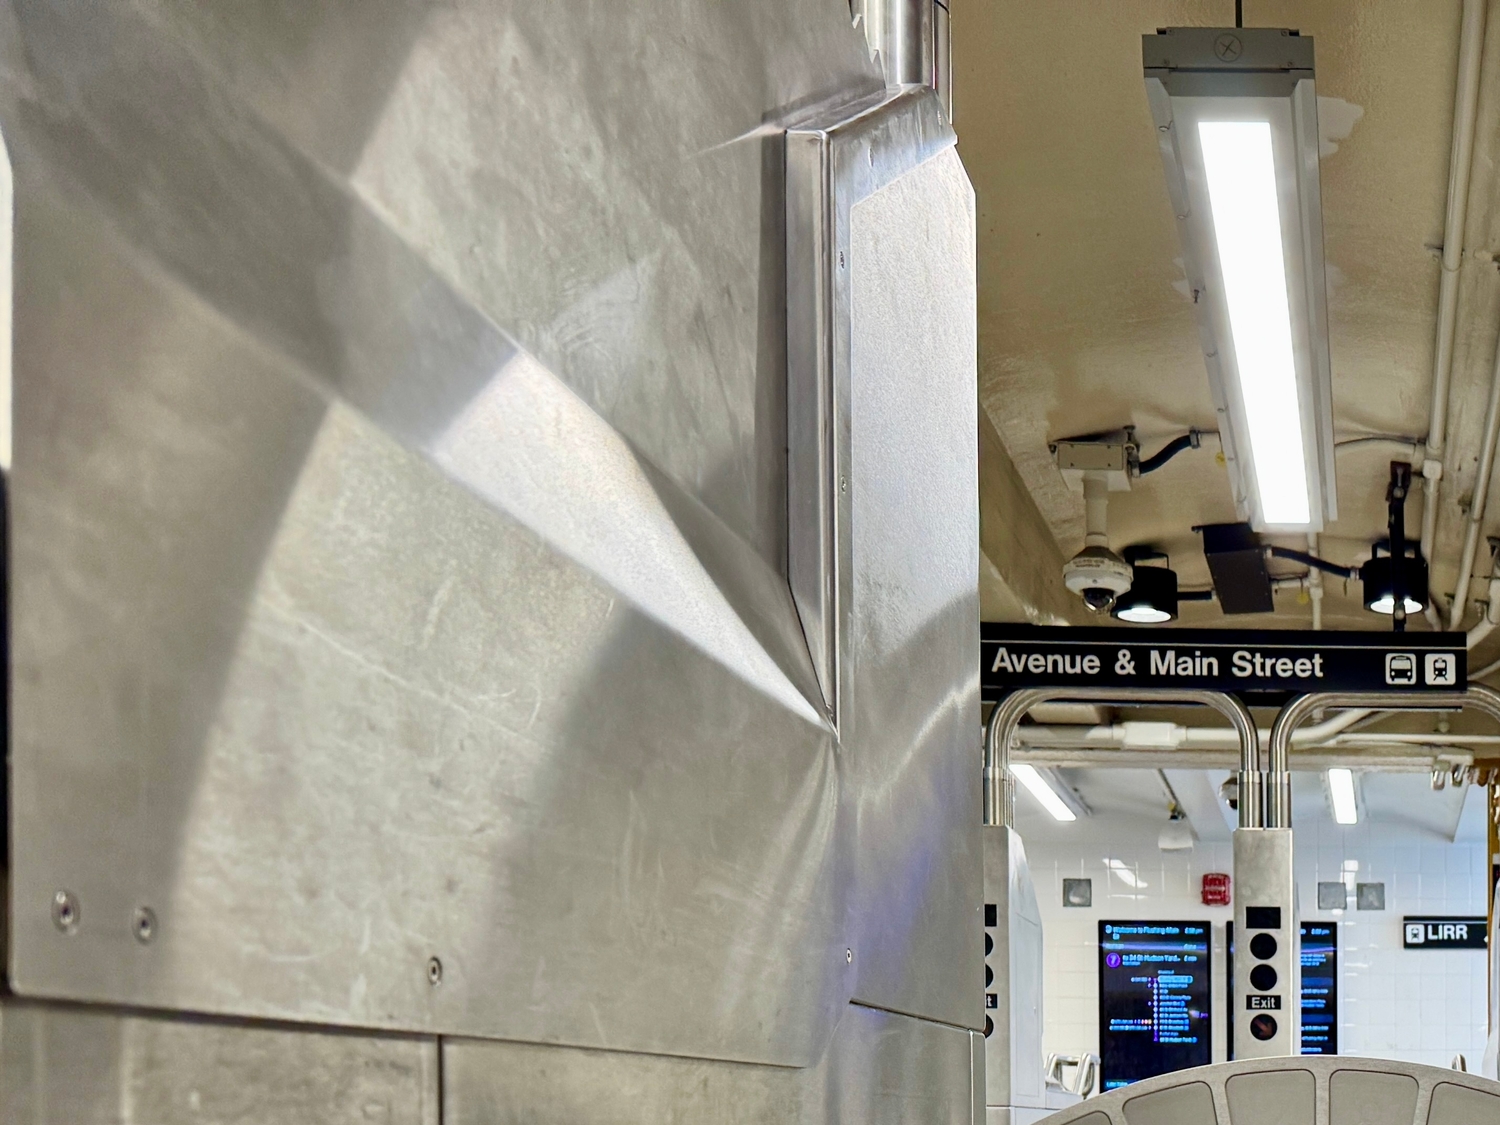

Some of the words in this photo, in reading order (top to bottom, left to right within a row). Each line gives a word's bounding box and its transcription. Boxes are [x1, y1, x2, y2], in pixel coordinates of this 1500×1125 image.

[991, 647, 1101, 674] Avenue
[1114, 649, 1137, 675] &
[1150, 650, 1219, 677] Main
[1231, 651, 1324, 678] Street
[1427, 924, 1468, 940] LIRR
[1251, 997, 1275, 1009] Exit
